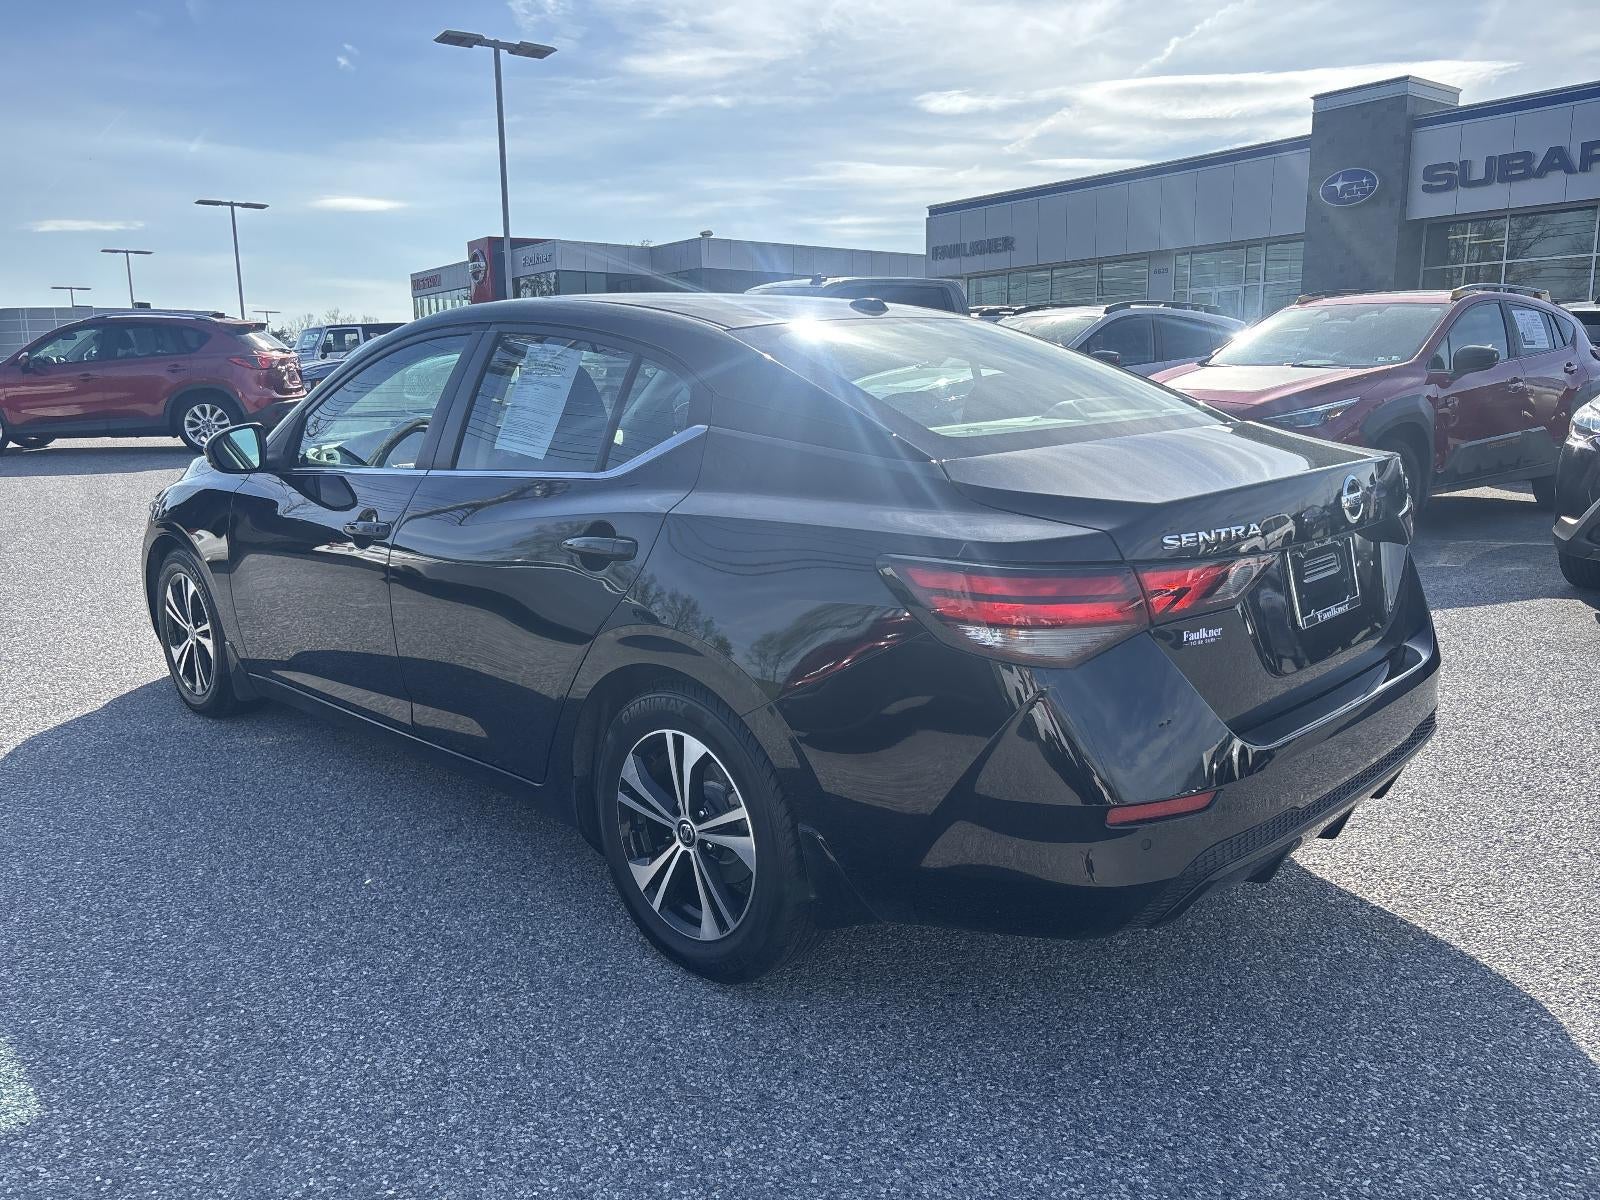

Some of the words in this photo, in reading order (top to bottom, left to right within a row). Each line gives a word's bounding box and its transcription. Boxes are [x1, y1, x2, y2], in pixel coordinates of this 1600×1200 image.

[931, 236, 1015, 261] FAULKNER
[522, 253, 552, 267] Faulkner
[1162, 523, 1262, 550] SENTRA
[1316, 603, 1350, 622] Faulkner
[1183, 627, 1223, 642] Faulkner
